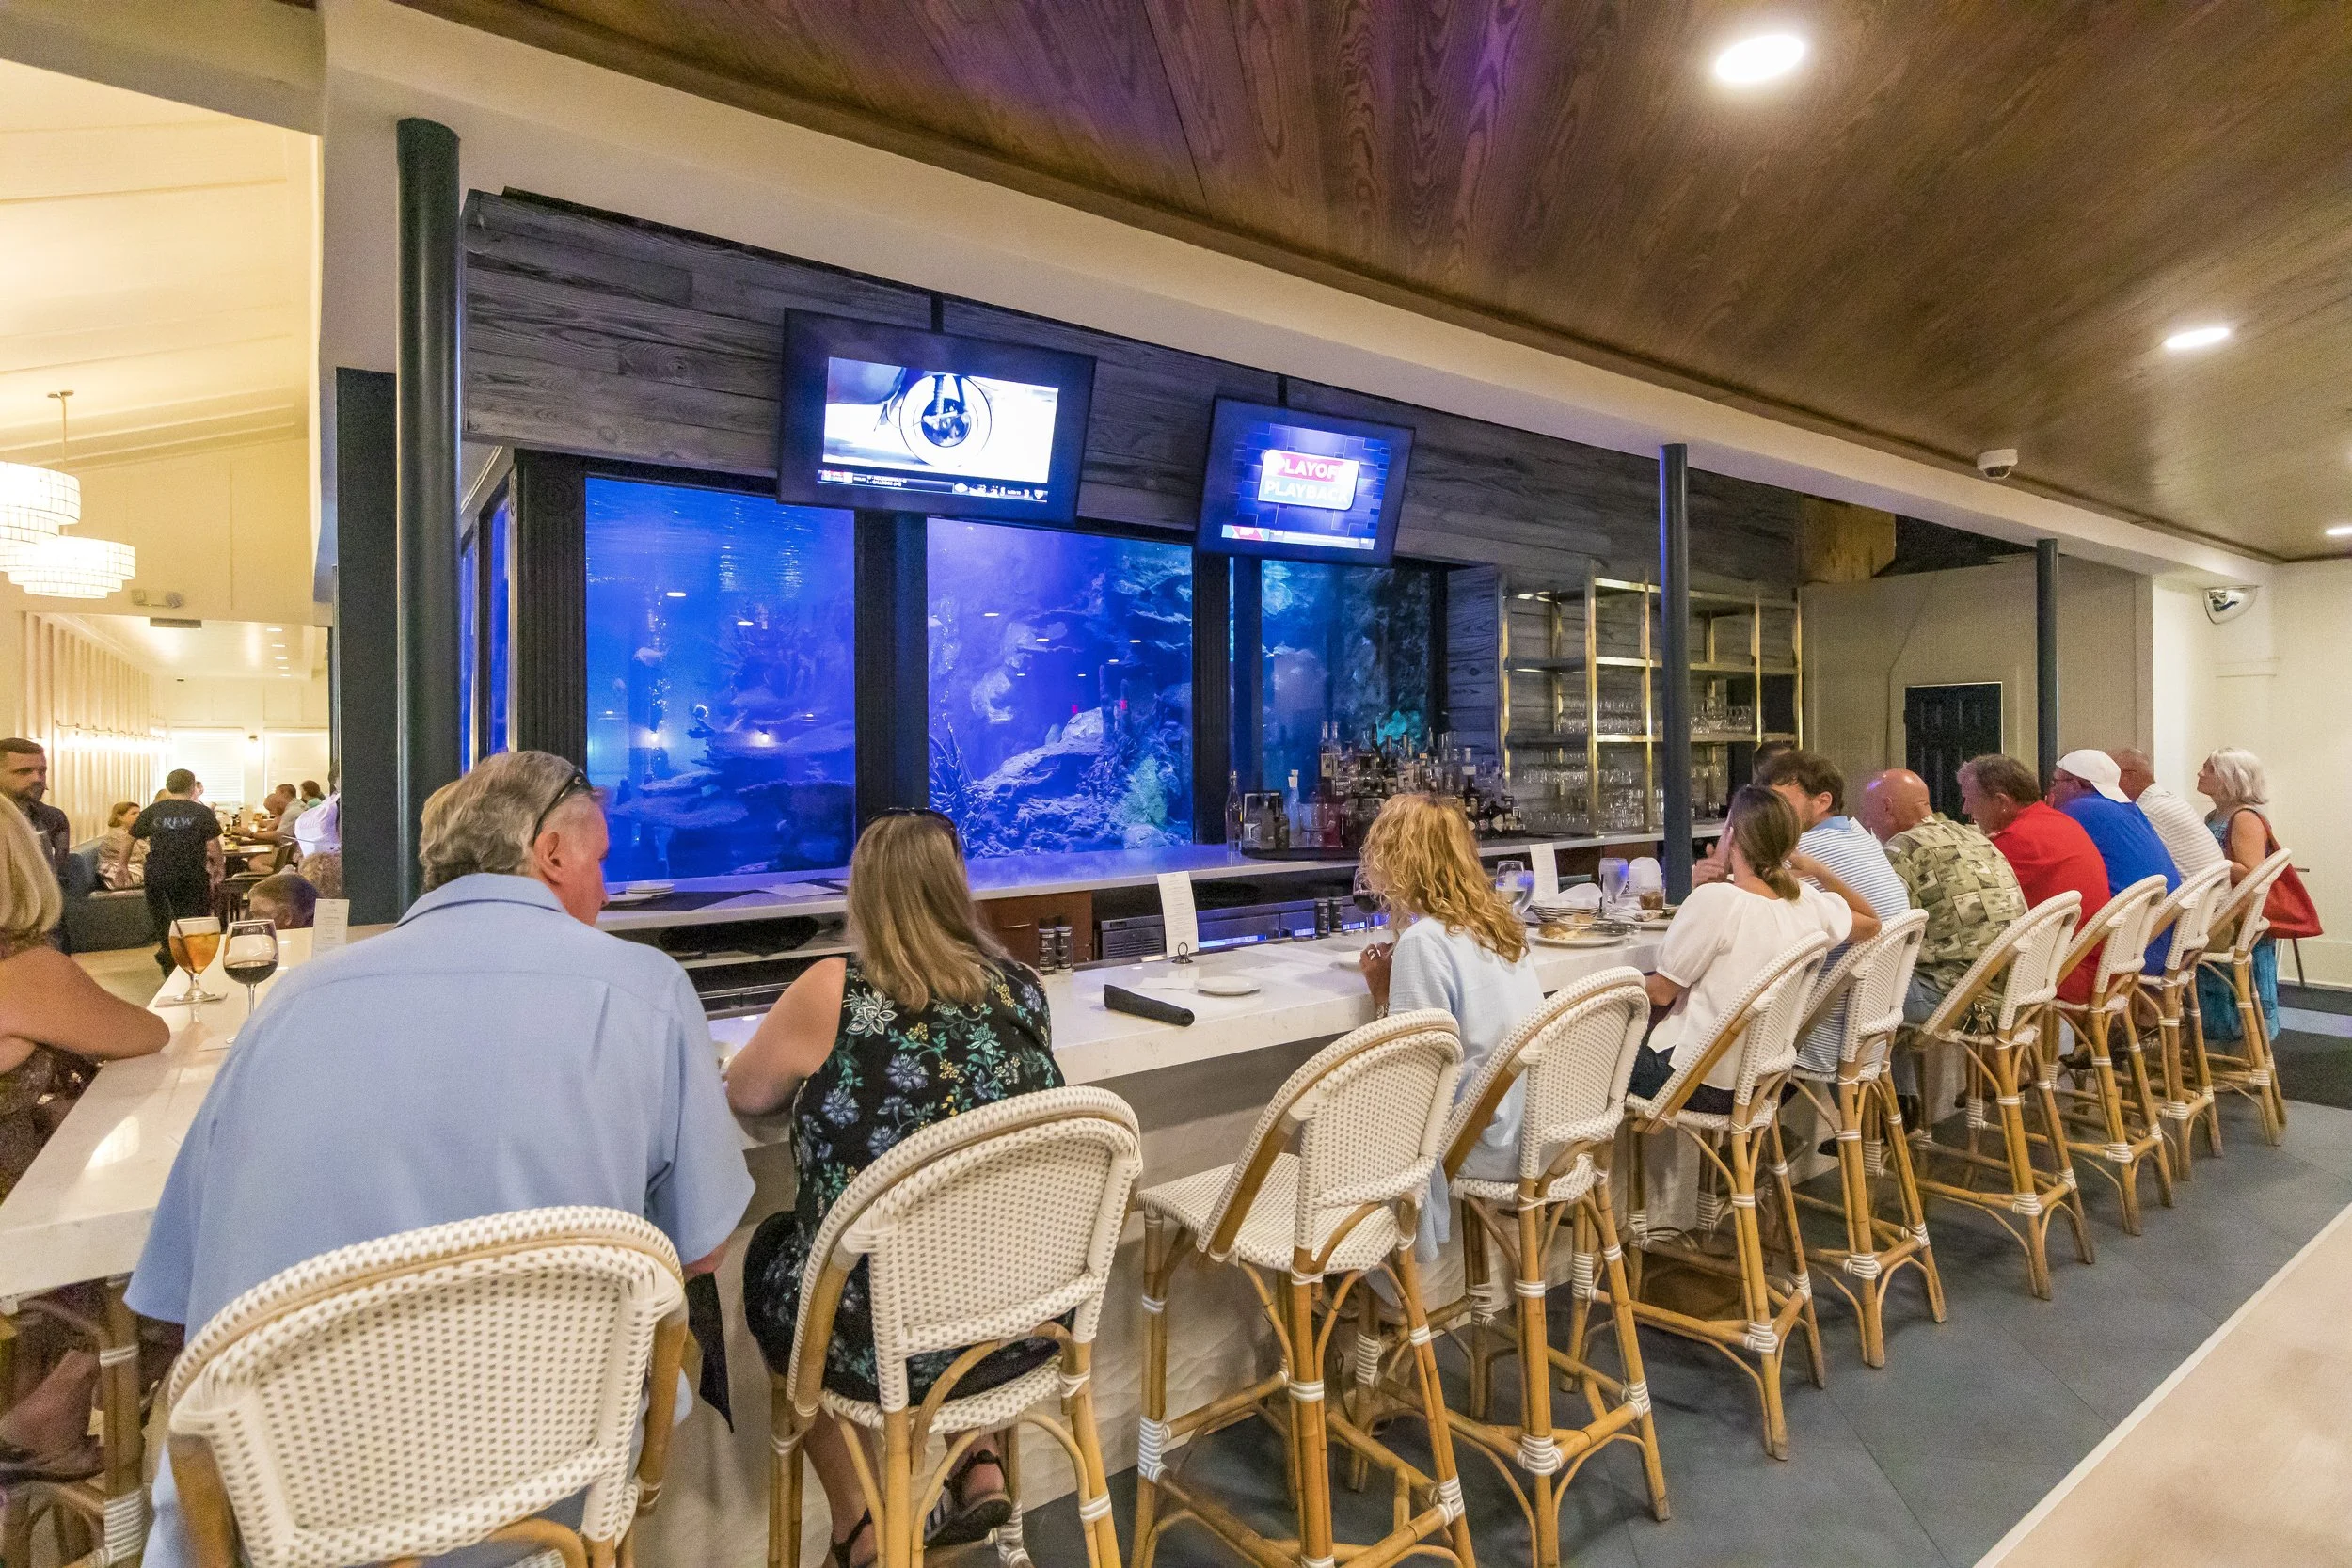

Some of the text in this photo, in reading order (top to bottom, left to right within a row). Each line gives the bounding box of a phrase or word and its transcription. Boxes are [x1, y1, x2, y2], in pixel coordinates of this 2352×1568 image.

[1277, 457, 1343, 481] PLAYOF
[1263, 479, 1352, 503] PLAYBACK
[152, 816, 195, 830] CREW
